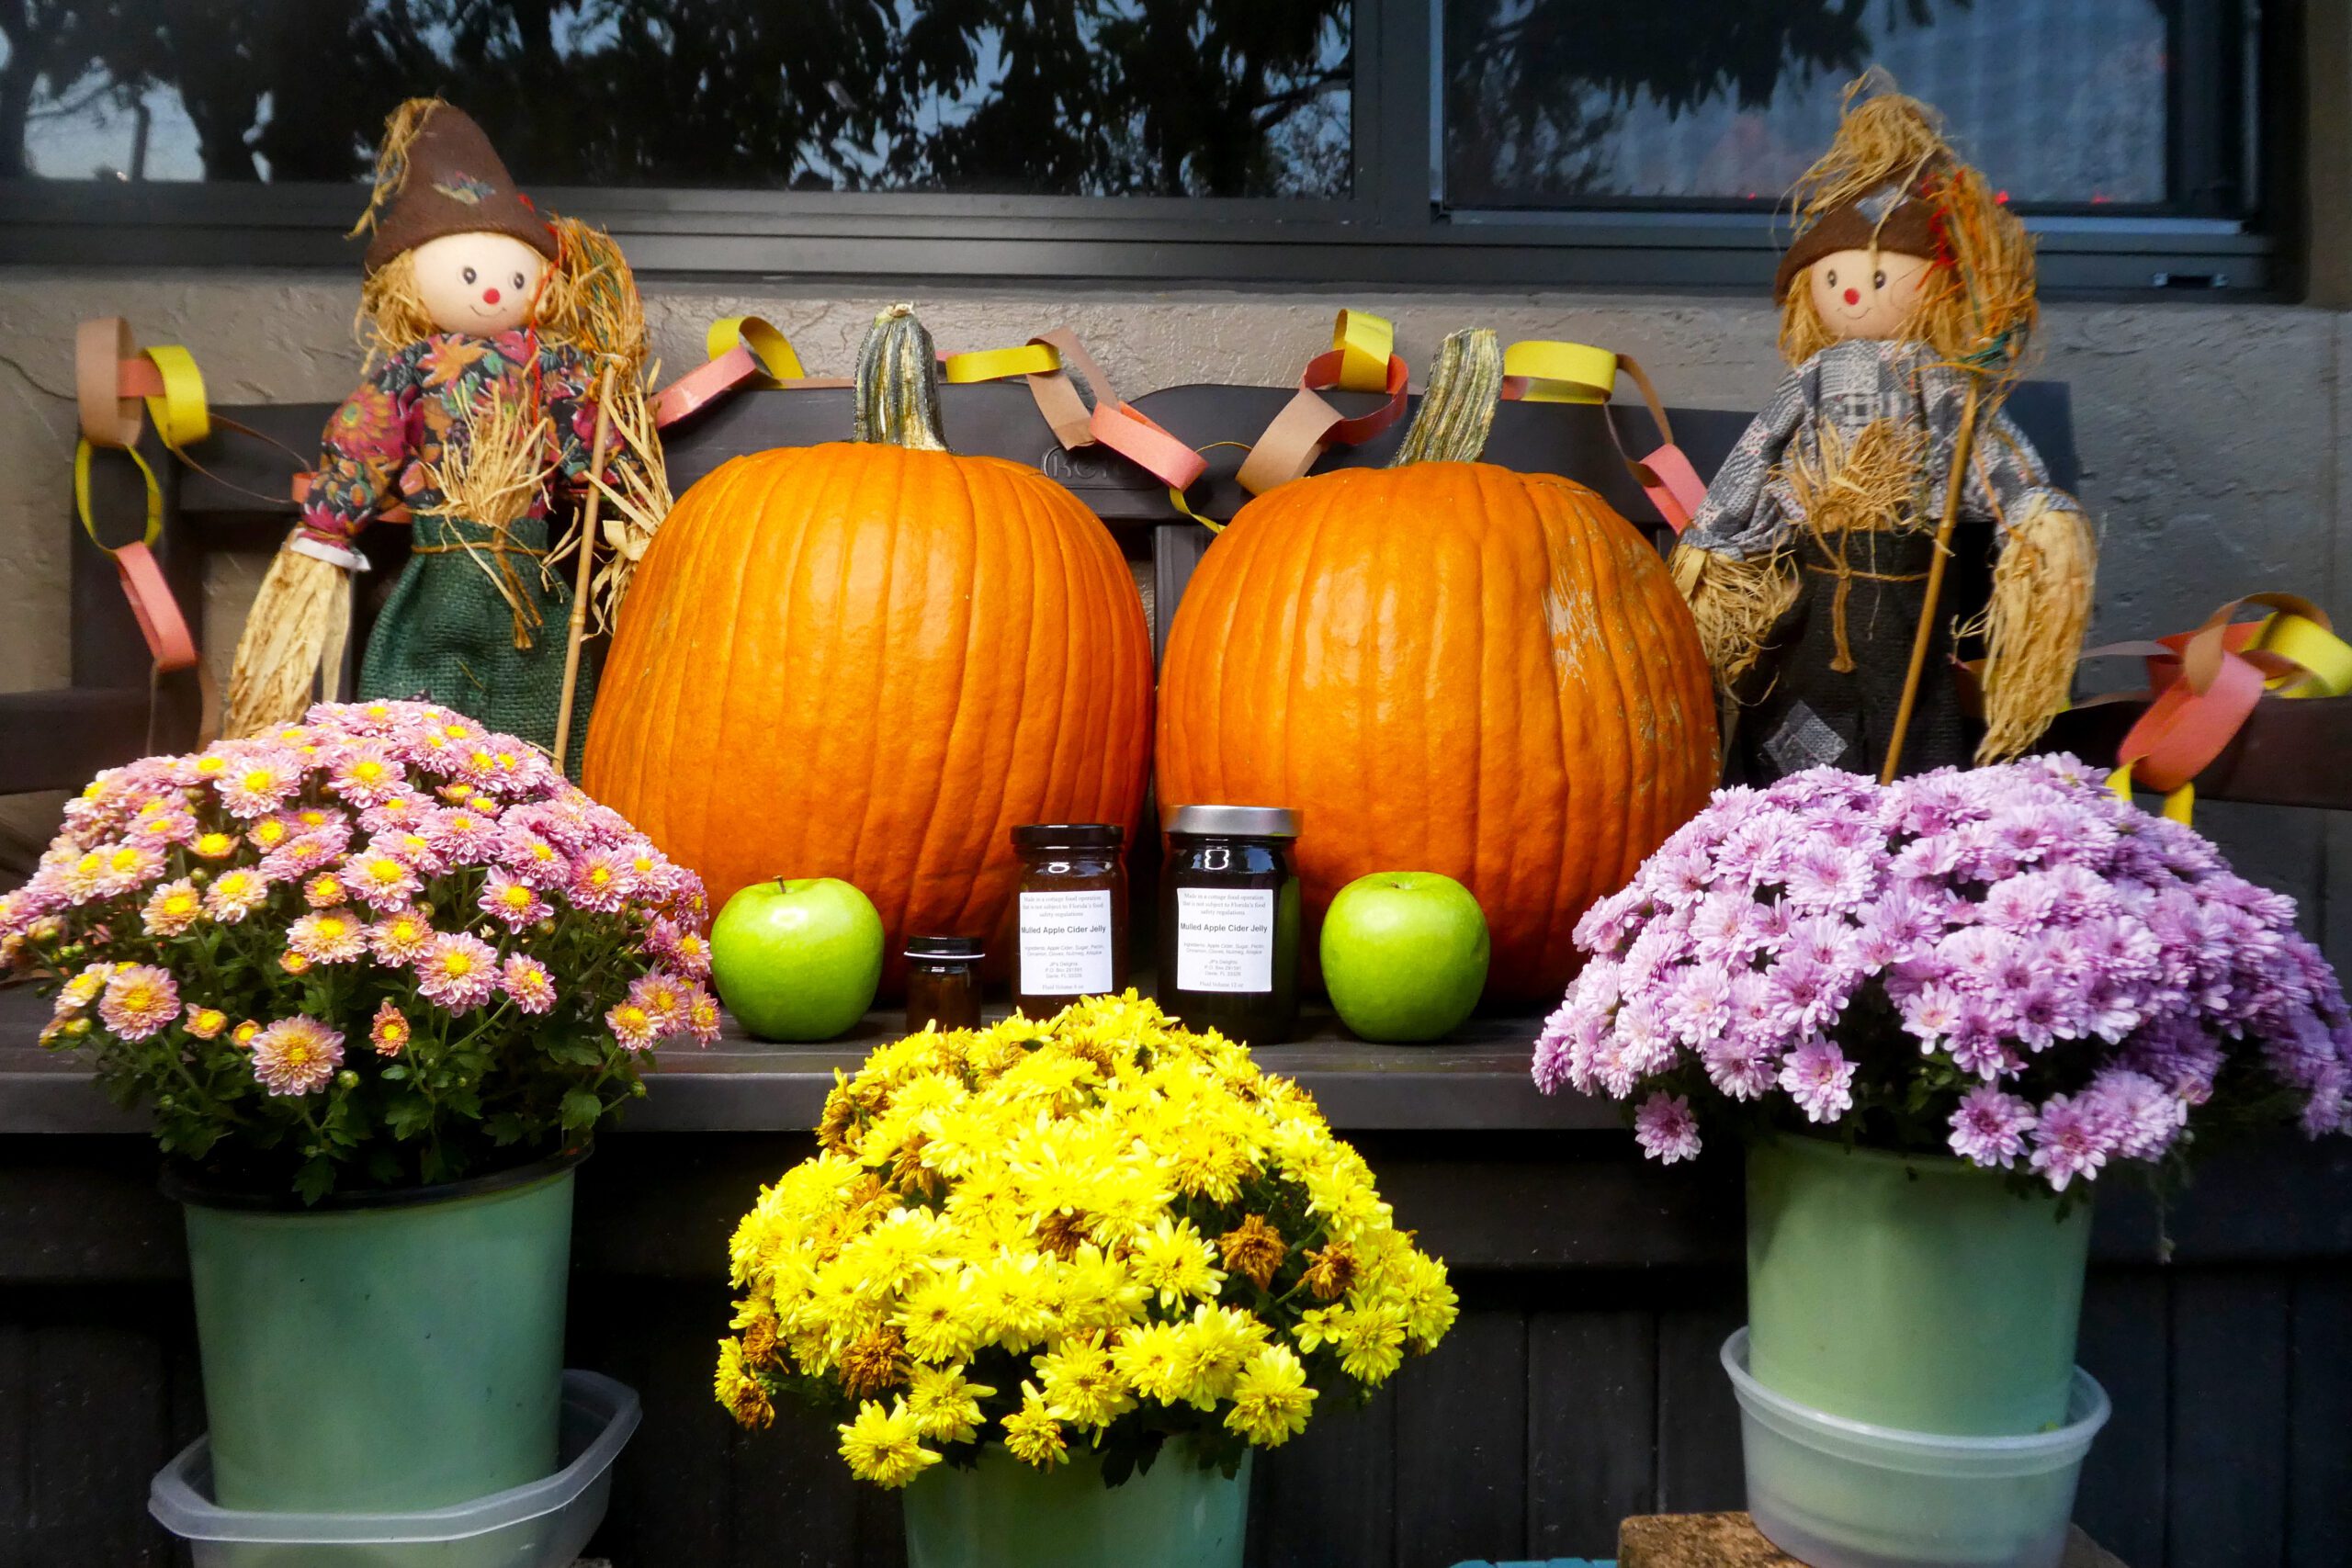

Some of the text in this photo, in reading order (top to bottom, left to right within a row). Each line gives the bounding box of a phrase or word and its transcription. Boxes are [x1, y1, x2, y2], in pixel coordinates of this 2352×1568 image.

[1043, 926, 1065, 935] Apple
[1090, 925, 1106, 934] Jelly
[1180, 923, 1202, 931] Mulled
[1204, 924, 1226, 933] Apple
[1250, 925, 1268, 934] Jelly
